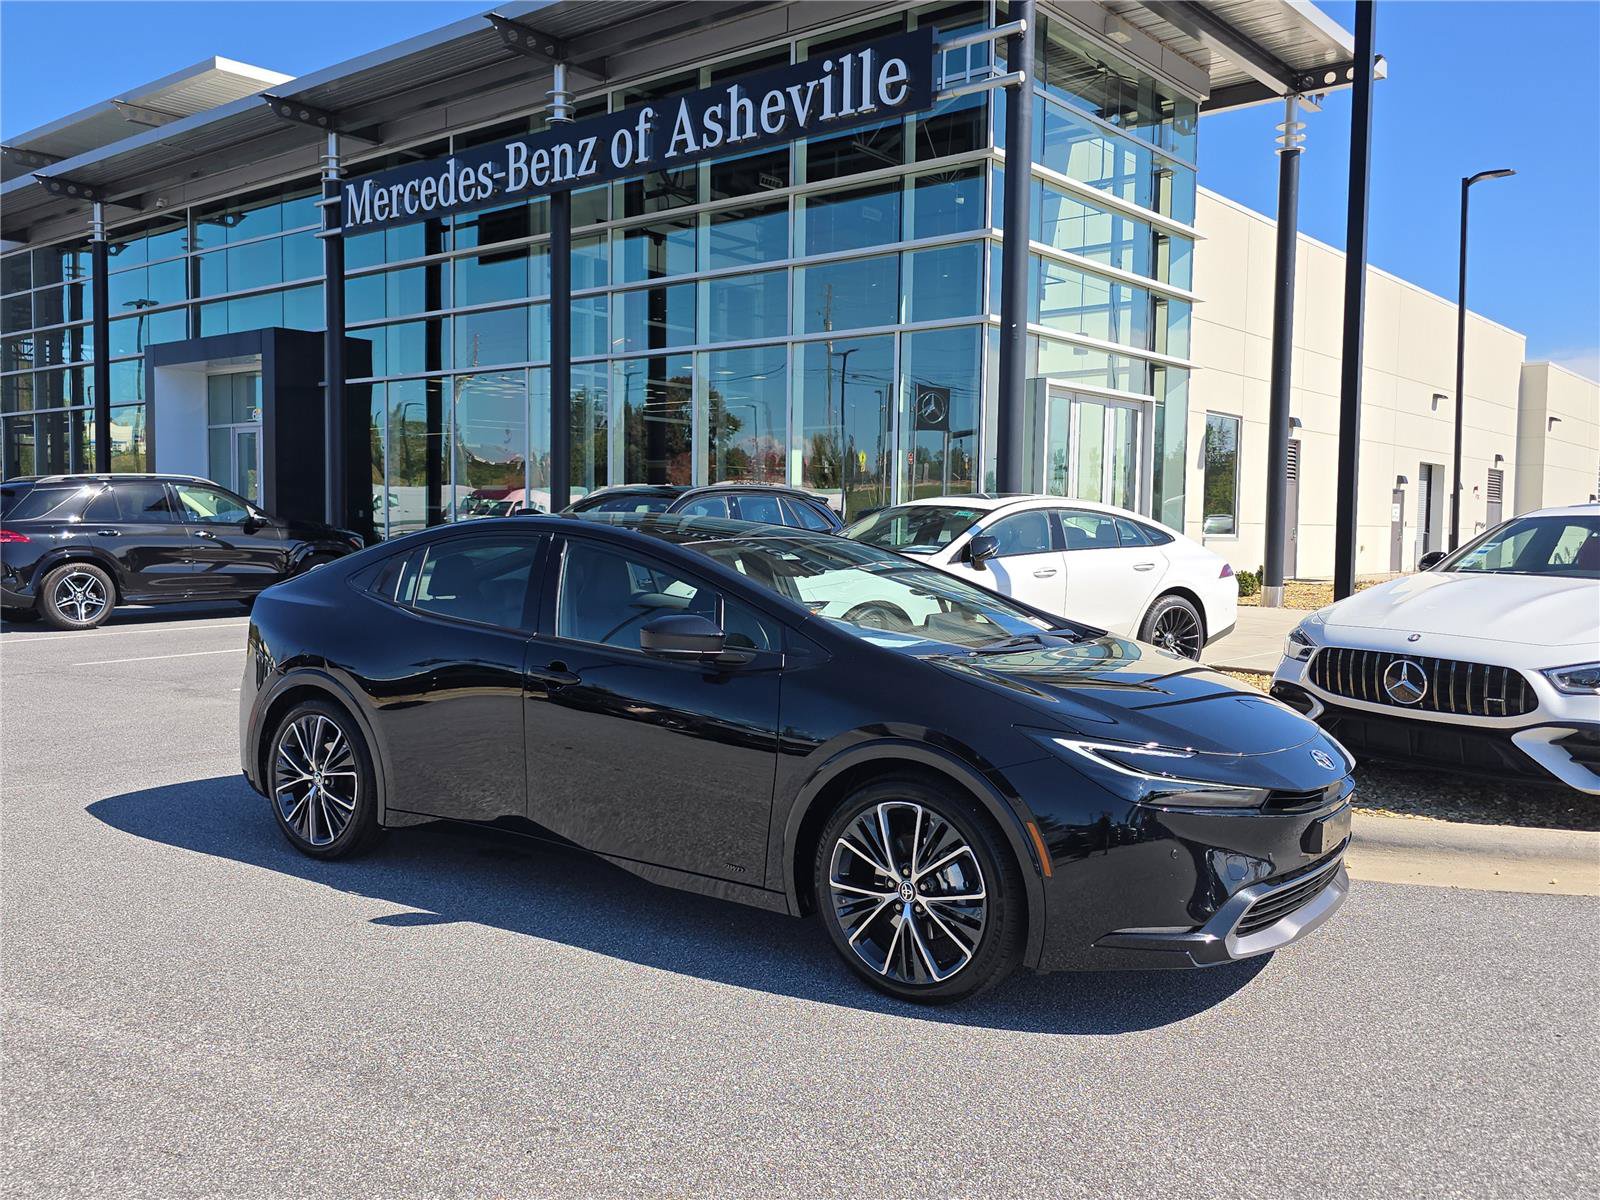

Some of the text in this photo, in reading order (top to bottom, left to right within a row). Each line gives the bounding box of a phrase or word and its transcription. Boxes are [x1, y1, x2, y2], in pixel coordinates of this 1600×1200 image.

[345, 48, 908, 228] Mercedes-Benz of Asheville
